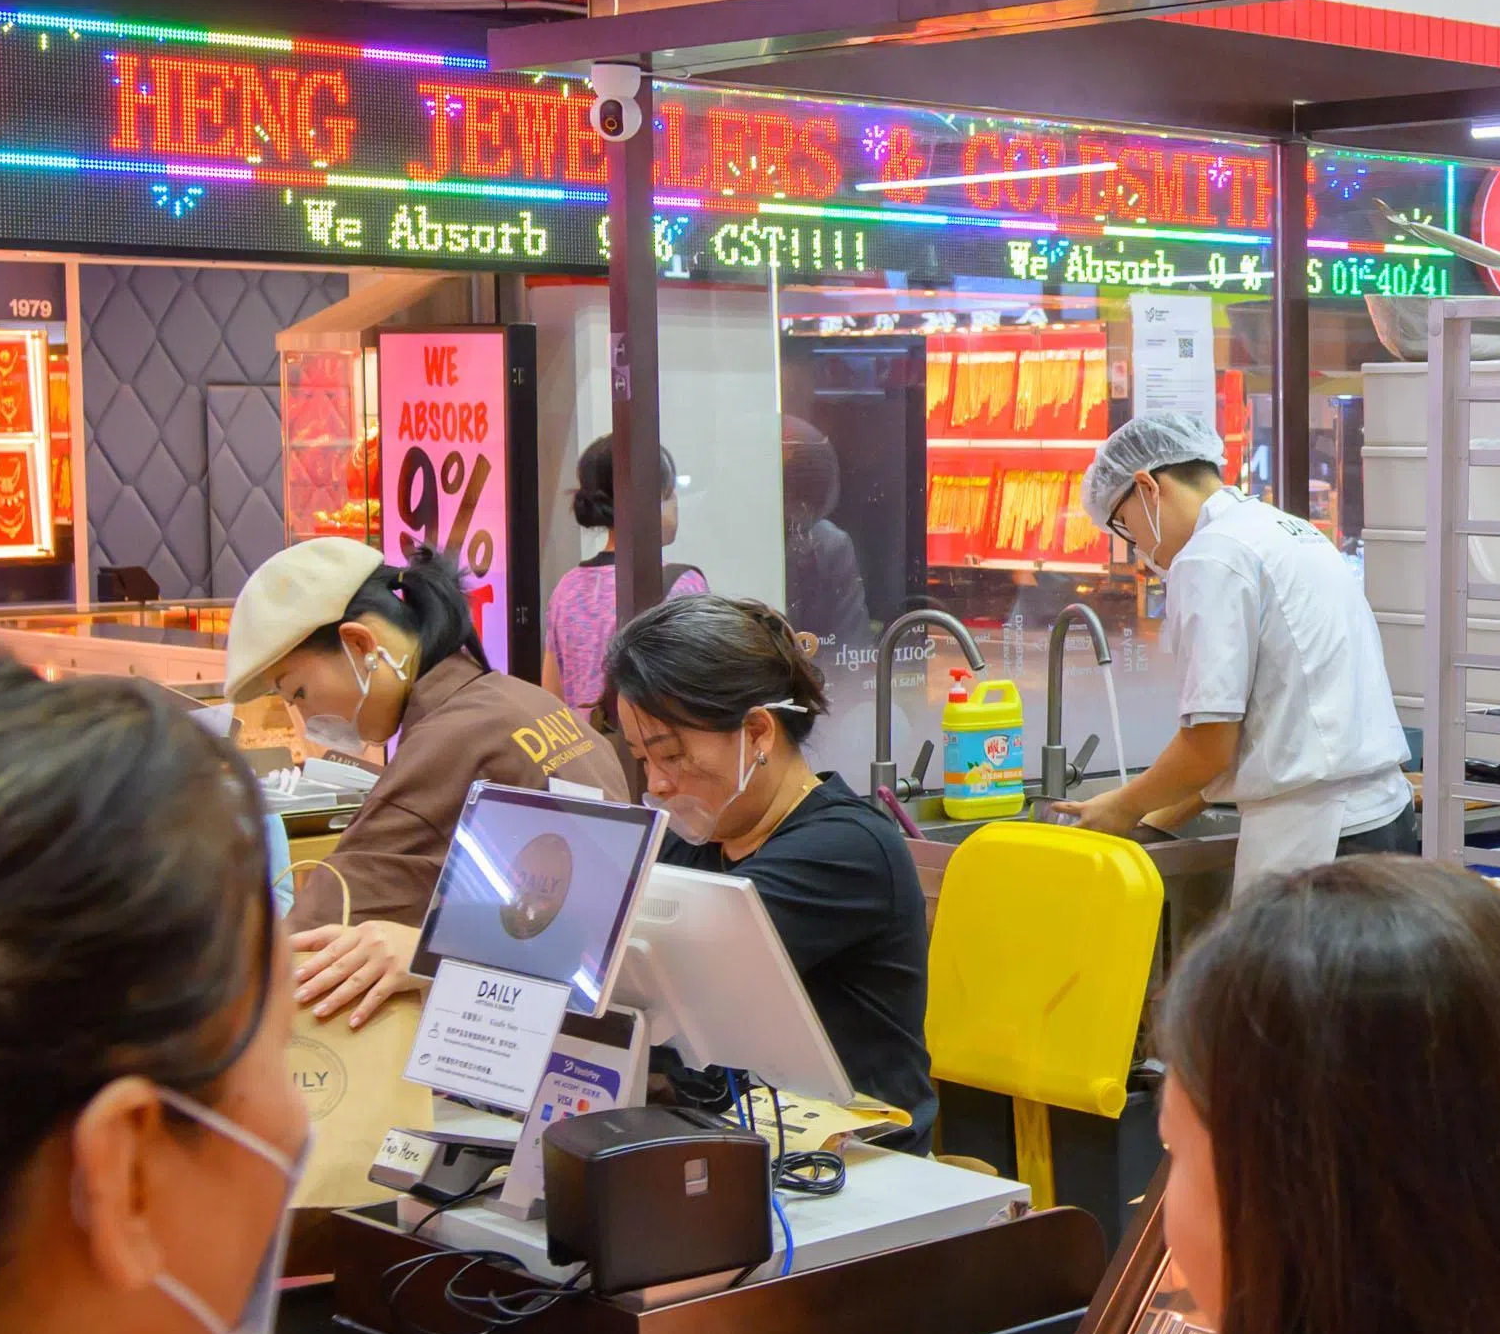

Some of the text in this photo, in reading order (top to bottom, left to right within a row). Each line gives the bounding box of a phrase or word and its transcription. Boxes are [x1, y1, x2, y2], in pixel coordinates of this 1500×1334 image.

[109, 52, 356, 165] HENG
[882, 124, 928, 205] &
[305, 200, 362, 249] We
[389, 204, 548, 259] Absorb
[1008, 240, 1048, 281] We
[1066, 241, 1176, 286] Absorb
[8, 298, 52, 319] 1979
[423, 345, 459, 388] WE
[398, 401, 489, 444] ABSORB
[397, 446, 495, 579] 9%
[511, 708, 584, 763] DAILY
[477, 980, 522, 1005] DAILY
[558, 1094, 573, 1107] VISA
[382, 1138, 420, 1162] Tap Here
